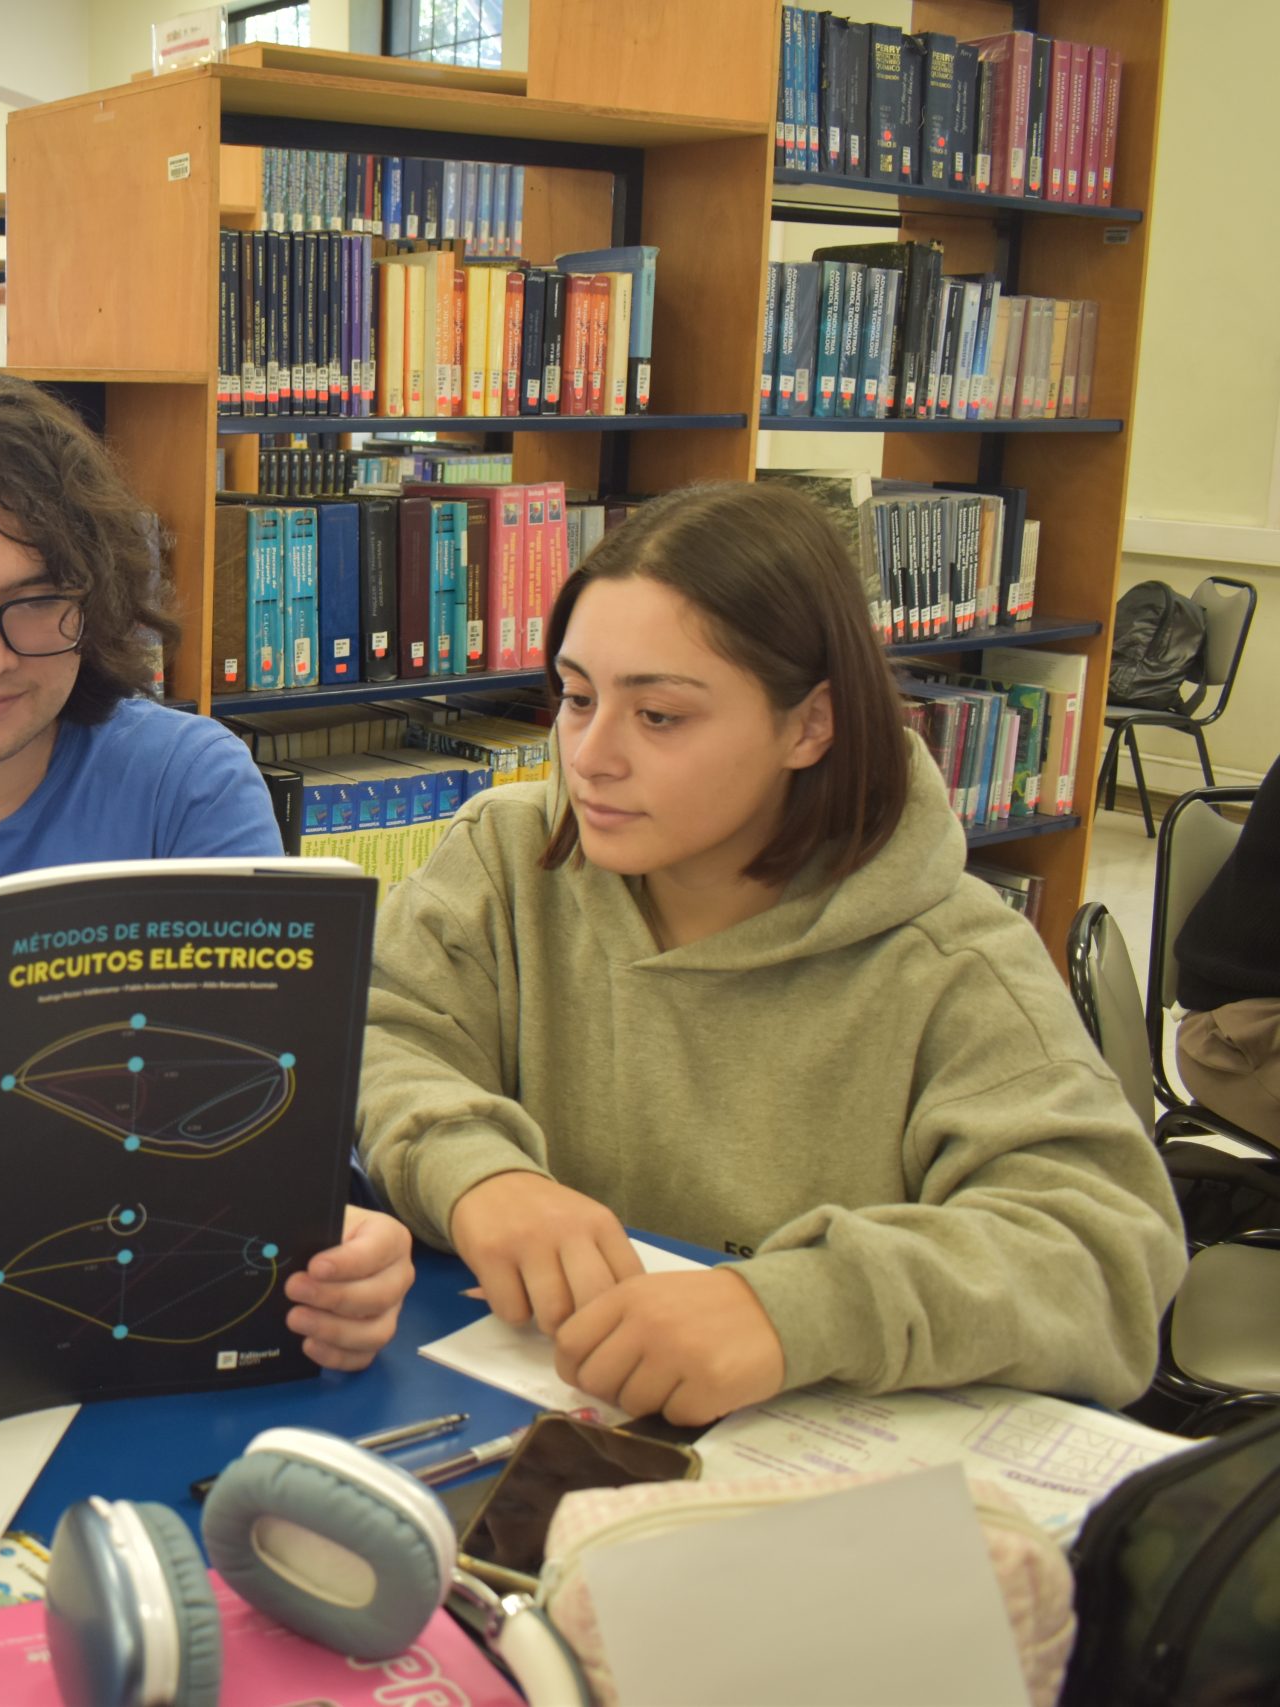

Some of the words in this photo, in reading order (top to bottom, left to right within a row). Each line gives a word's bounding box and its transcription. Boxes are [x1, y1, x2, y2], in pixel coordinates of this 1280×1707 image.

[875, 43, 901, 53] PERRY
[932, 50, 954, 62] PERRY
[769, 267, 777, 309] ADVANCED
[790, 268, 798, 310] ADVANCED
[827, 270, 835, 304] CONTROL
[833, 270, 841, 312] ADVANCED
[849, 271, 857, 305] CONTROL
[854, 272, 863, 312] ADVANCED
[878, 275, 886, 315] ADVANCED
[787, 311, 795, 354] INDUSTRIAL
[824, 306, 833, 355] TECHNOLOGY
[830, 313, 838, 355] INDUSTRIAL
[845, 307, 854, 356] TECHNOLOGY
[851, 313, 860, 356] INDUSTRIAL
[869, 310, 877, 359] TECHNOLOGY
[873, 316, 883, 358] INDUSTRIAL
[12, 925, 108, 955] MÉTODOS
[115, 923, 140, 940] DE
[147, 918, 281, 939] RESOLUCIÓN
[288, 922, 315, 939] DE
[9, 949, 143, 988] CIRCUITOS
[150, 943, 314, 970] ELÉCTRICOS
